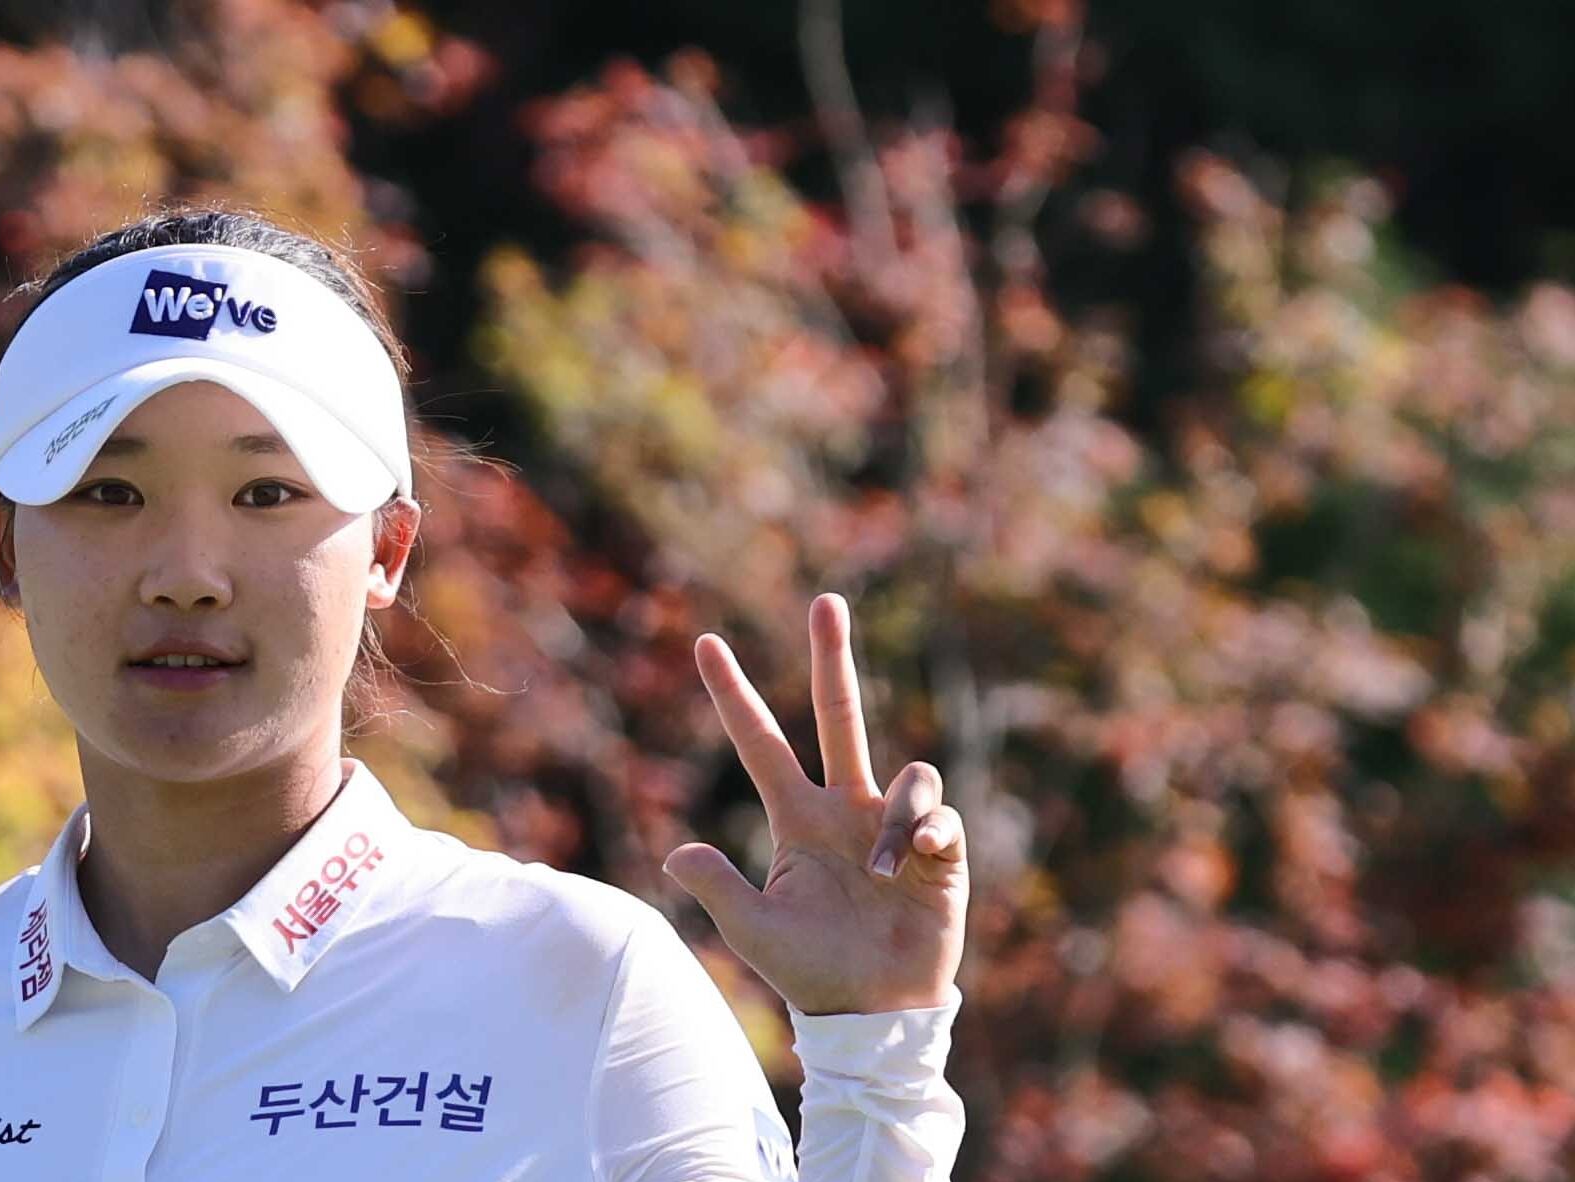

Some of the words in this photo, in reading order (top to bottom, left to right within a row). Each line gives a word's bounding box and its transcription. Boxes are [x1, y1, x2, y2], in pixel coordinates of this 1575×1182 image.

[143, 284, 278, 334] We've
[272, 831, 385, 954] 서울우유
[19, 898, 54, 1001] 세라젬
[249, 1071, 493, 1136] 두산건설
